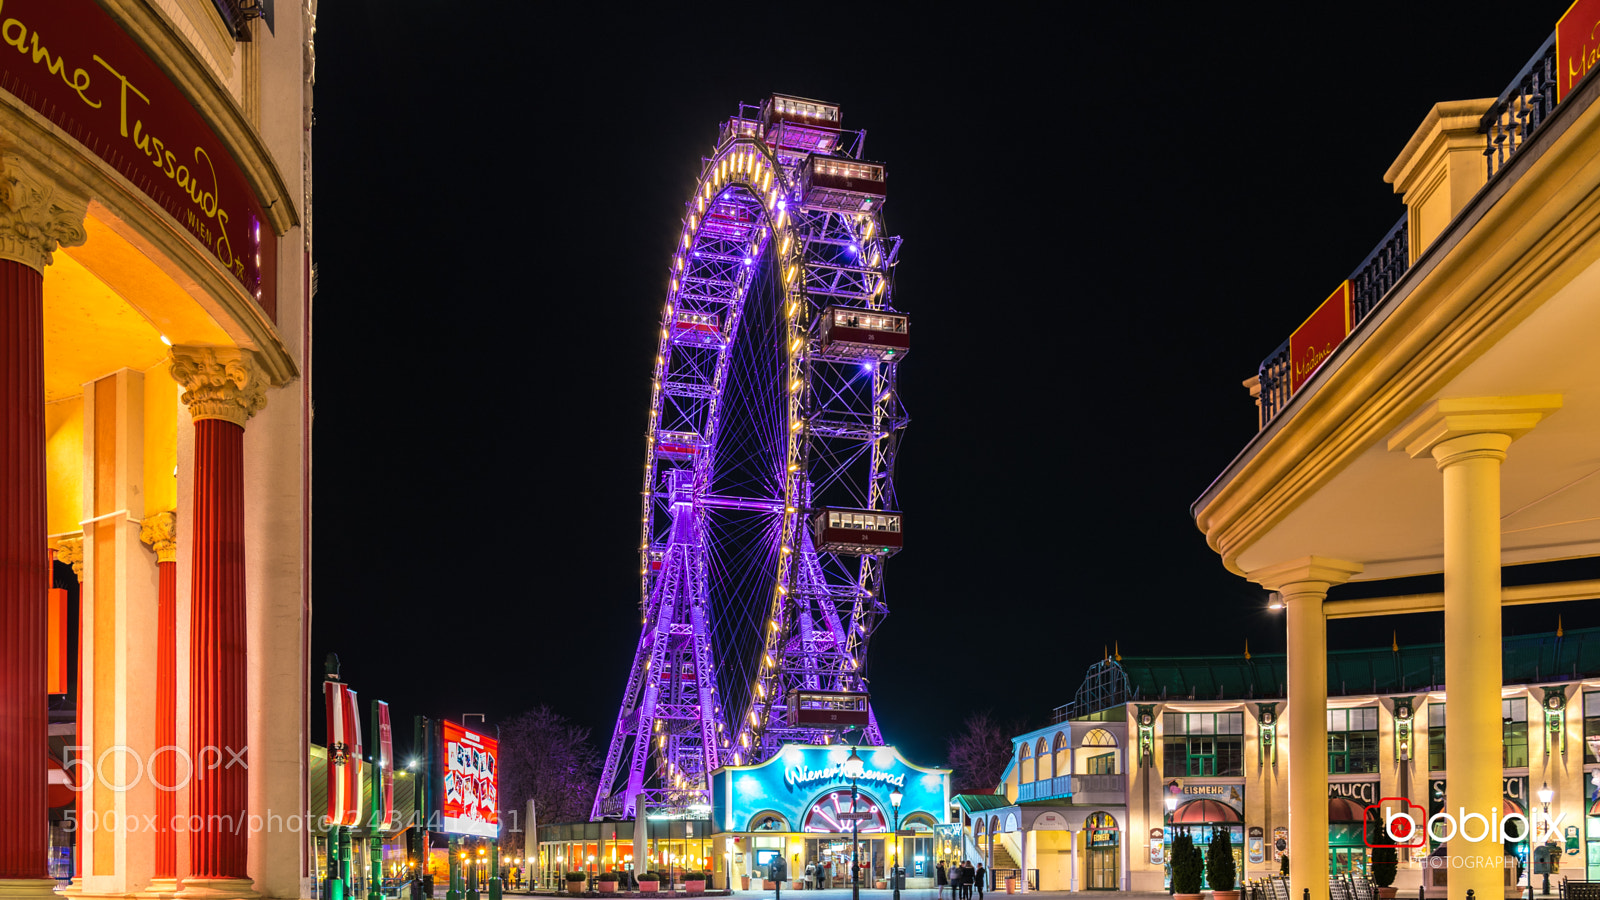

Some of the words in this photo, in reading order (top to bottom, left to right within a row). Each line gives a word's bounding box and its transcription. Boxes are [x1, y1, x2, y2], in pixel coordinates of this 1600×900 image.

[0, 0, 101, 108] ame
[93, 54, 232, 267] Tussauds
[187, 208, 211, 245] WIEN
[1296, 342, 1332, 382] Madame
[785, 764, 839, 785] Wiener
[1184, 786, 1224, 794] EISMEHR
[1328, 783, 1375, 804] MUCCI
